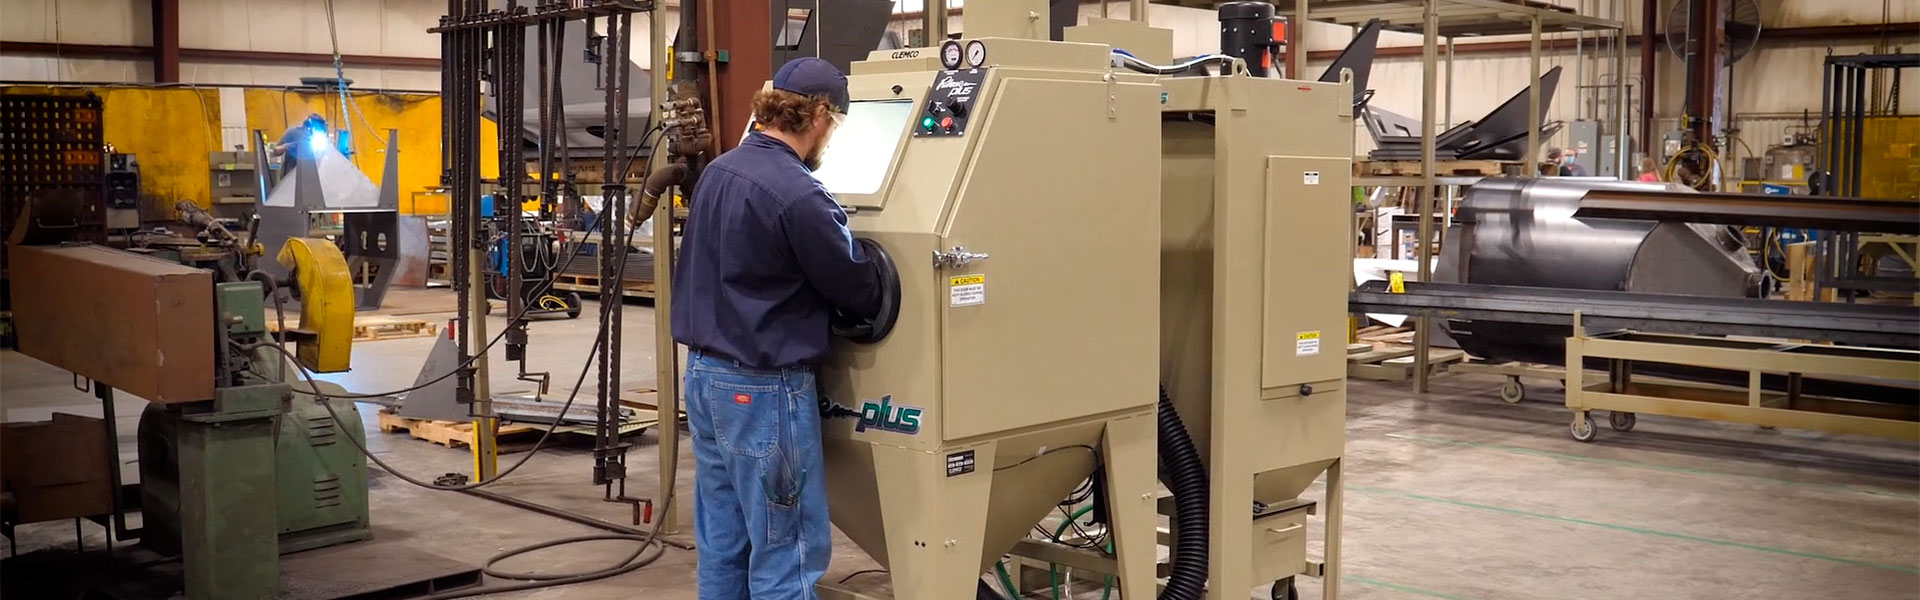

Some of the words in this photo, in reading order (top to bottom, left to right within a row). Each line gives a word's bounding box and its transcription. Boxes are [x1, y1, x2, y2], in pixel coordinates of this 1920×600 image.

[891, 50, 920, 60] CLEMCO
[960, 276, 981, 284] CAUTION
[855, 394, 922, 435] plus
